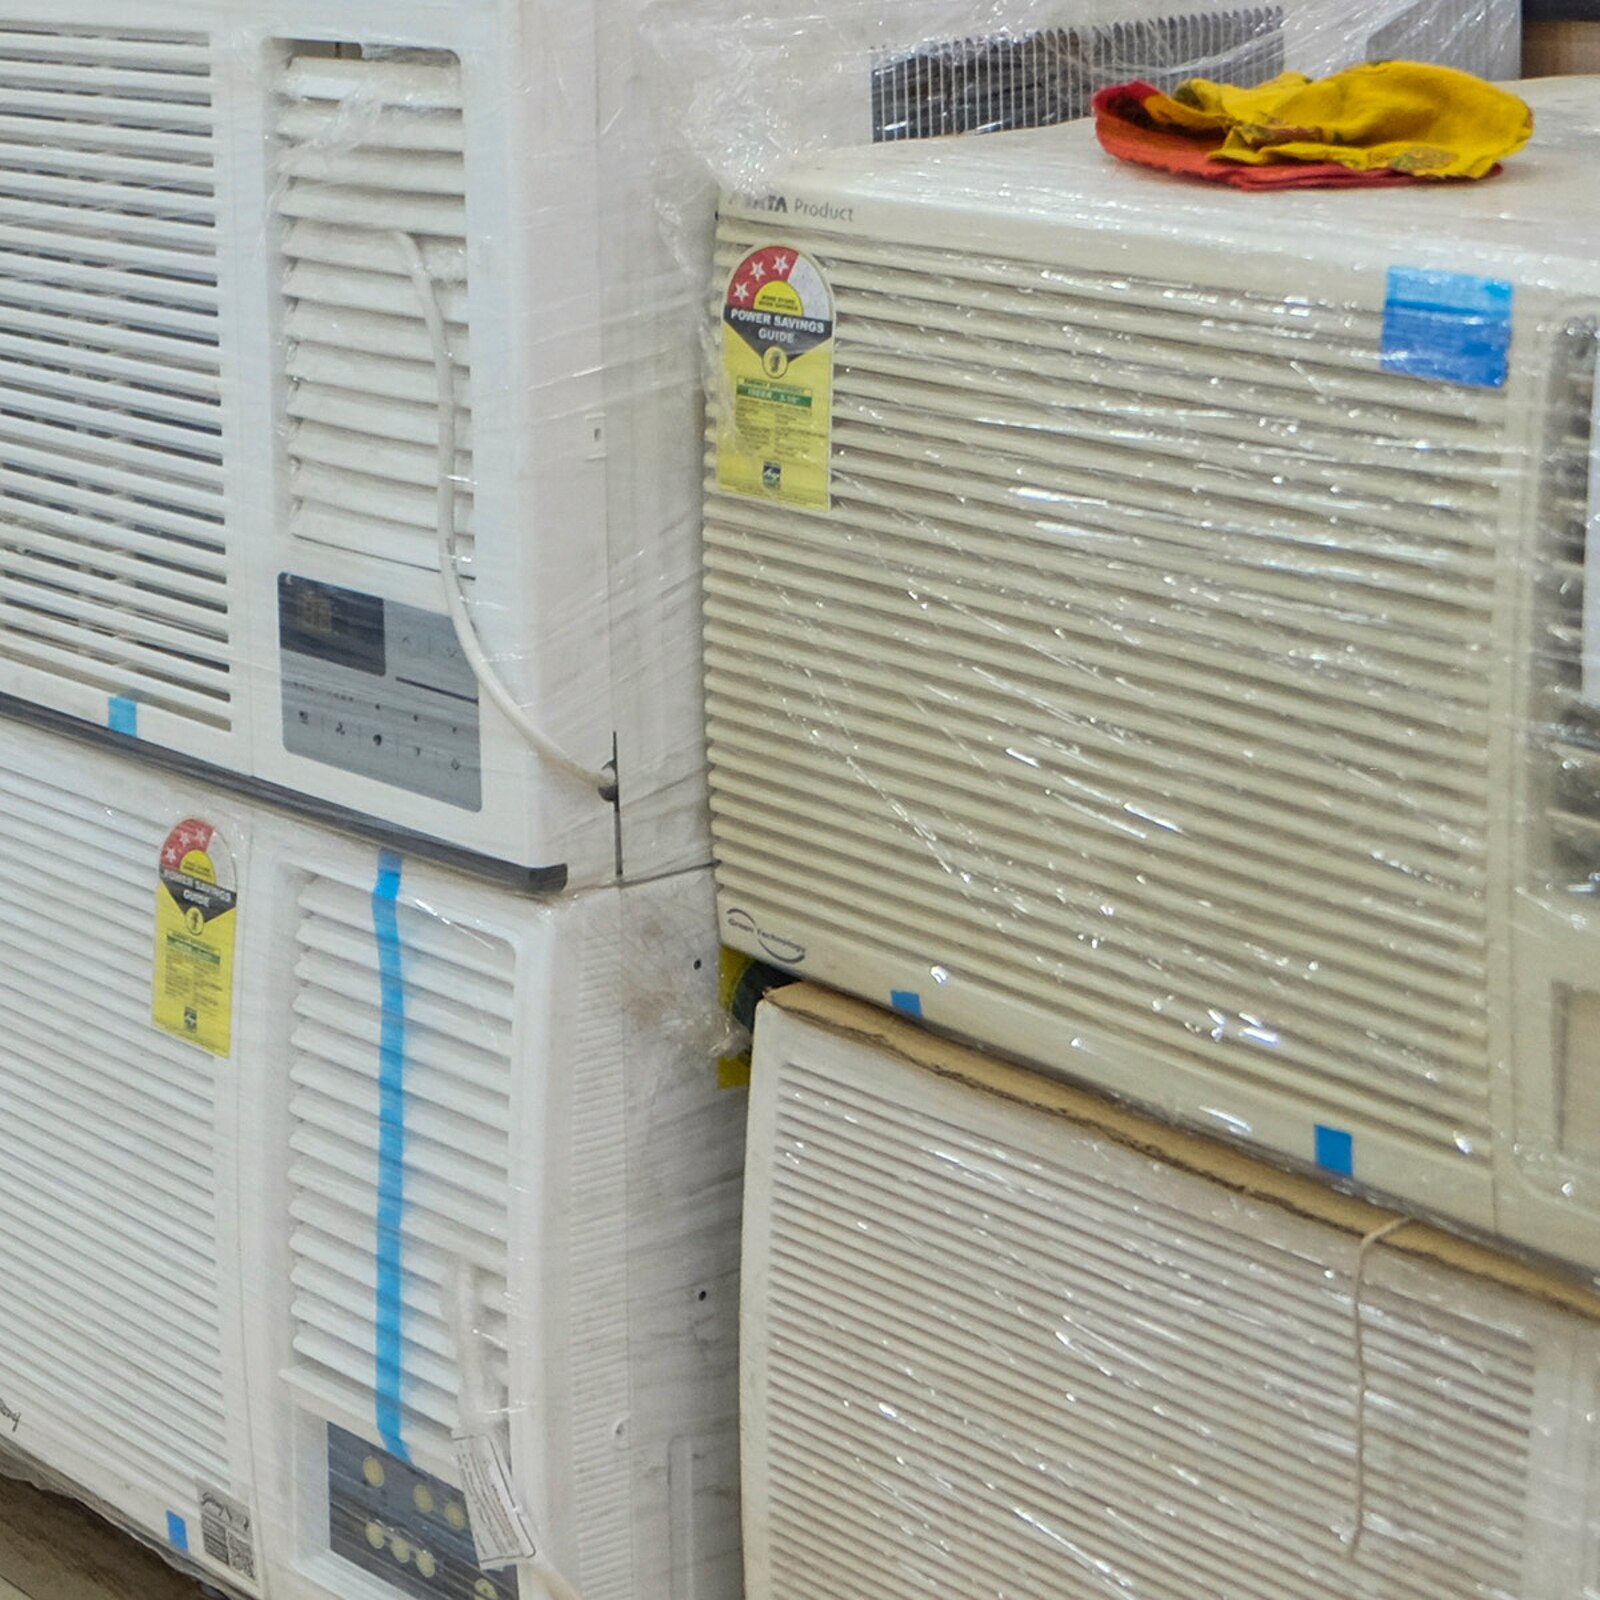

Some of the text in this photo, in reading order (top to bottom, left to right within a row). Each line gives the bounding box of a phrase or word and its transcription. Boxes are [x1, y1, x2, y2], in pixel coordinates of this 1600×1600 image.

[793, 199, 855, 222] Product
[730, 307, 826, 335] POWER SAVINGS
[757, 327, 796, 344] GUIDE
[163, 867, 232, 903] POWER SAVINGS
[183, 888, 210, 908] GUIDE
